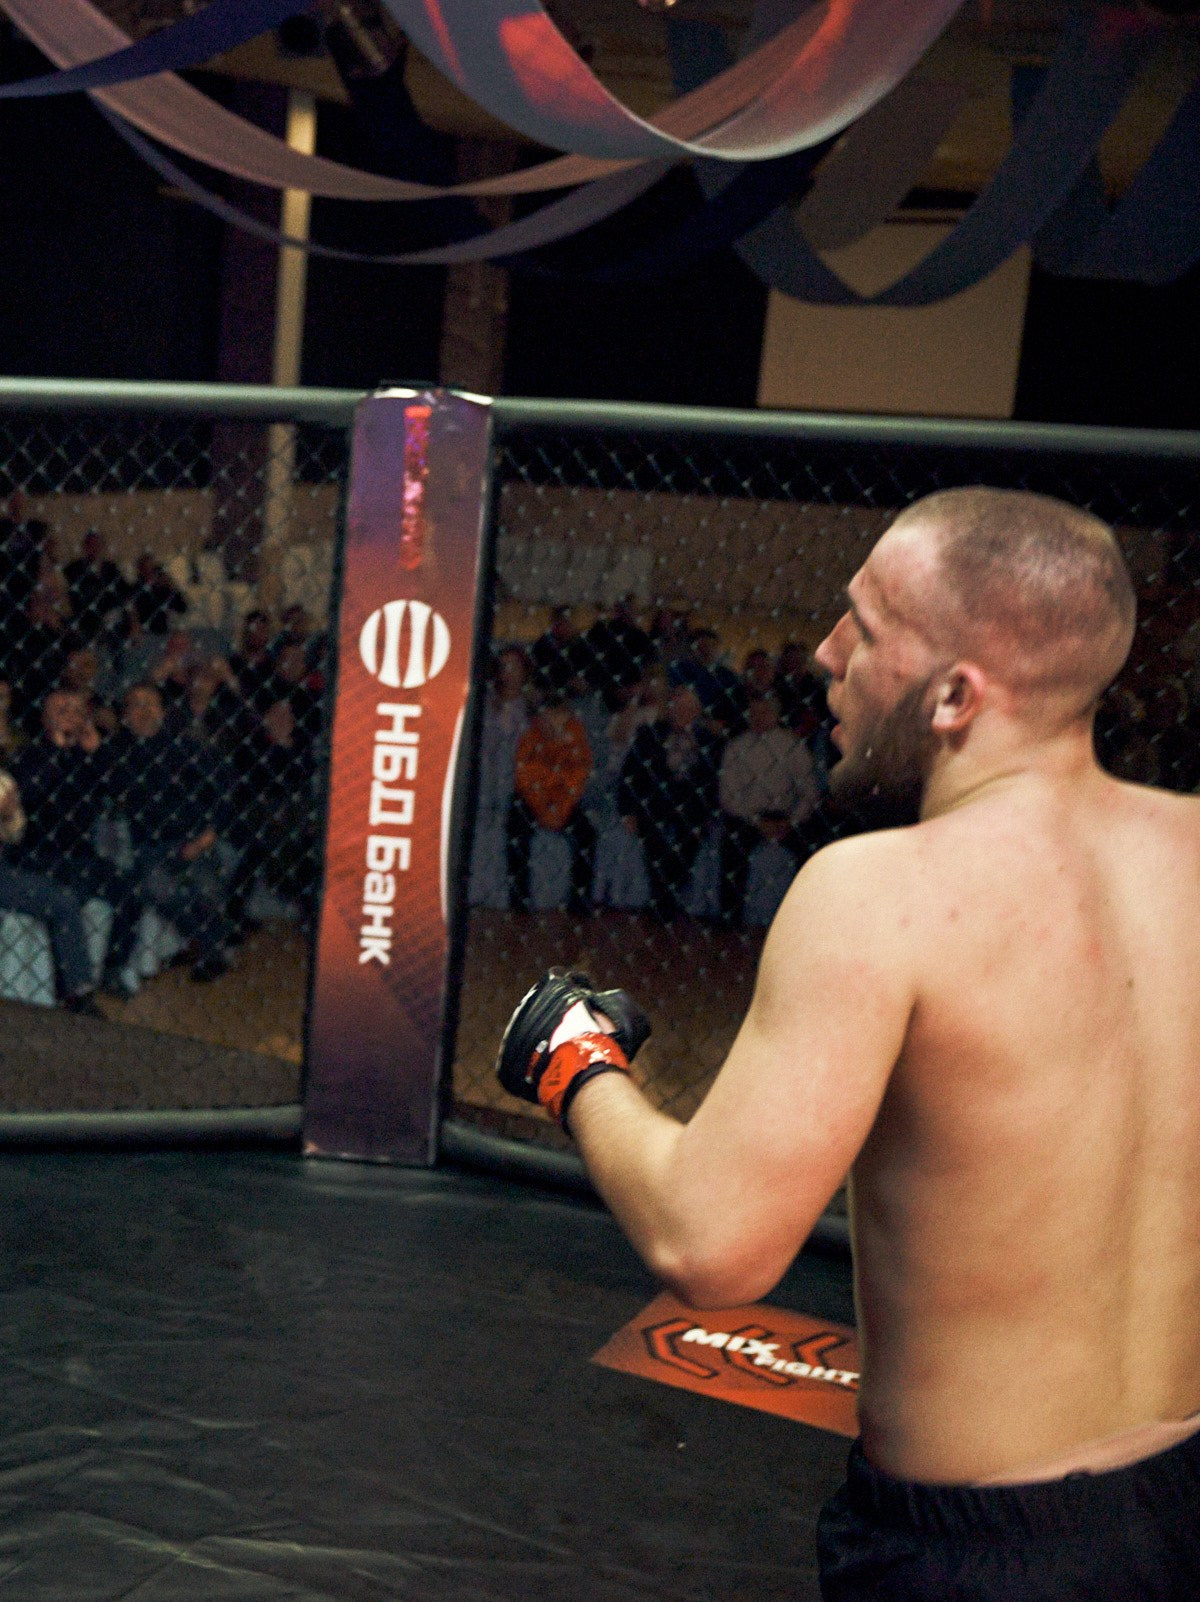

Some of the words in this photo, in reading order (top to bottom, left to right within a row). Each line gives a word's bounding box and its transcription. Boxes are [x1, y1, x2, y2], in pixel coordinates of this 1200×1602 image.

[368, 702, 423, 826] НБД
[358, 835, 412, 965] Банк
[682, 1328, 782, 1358] MIX
